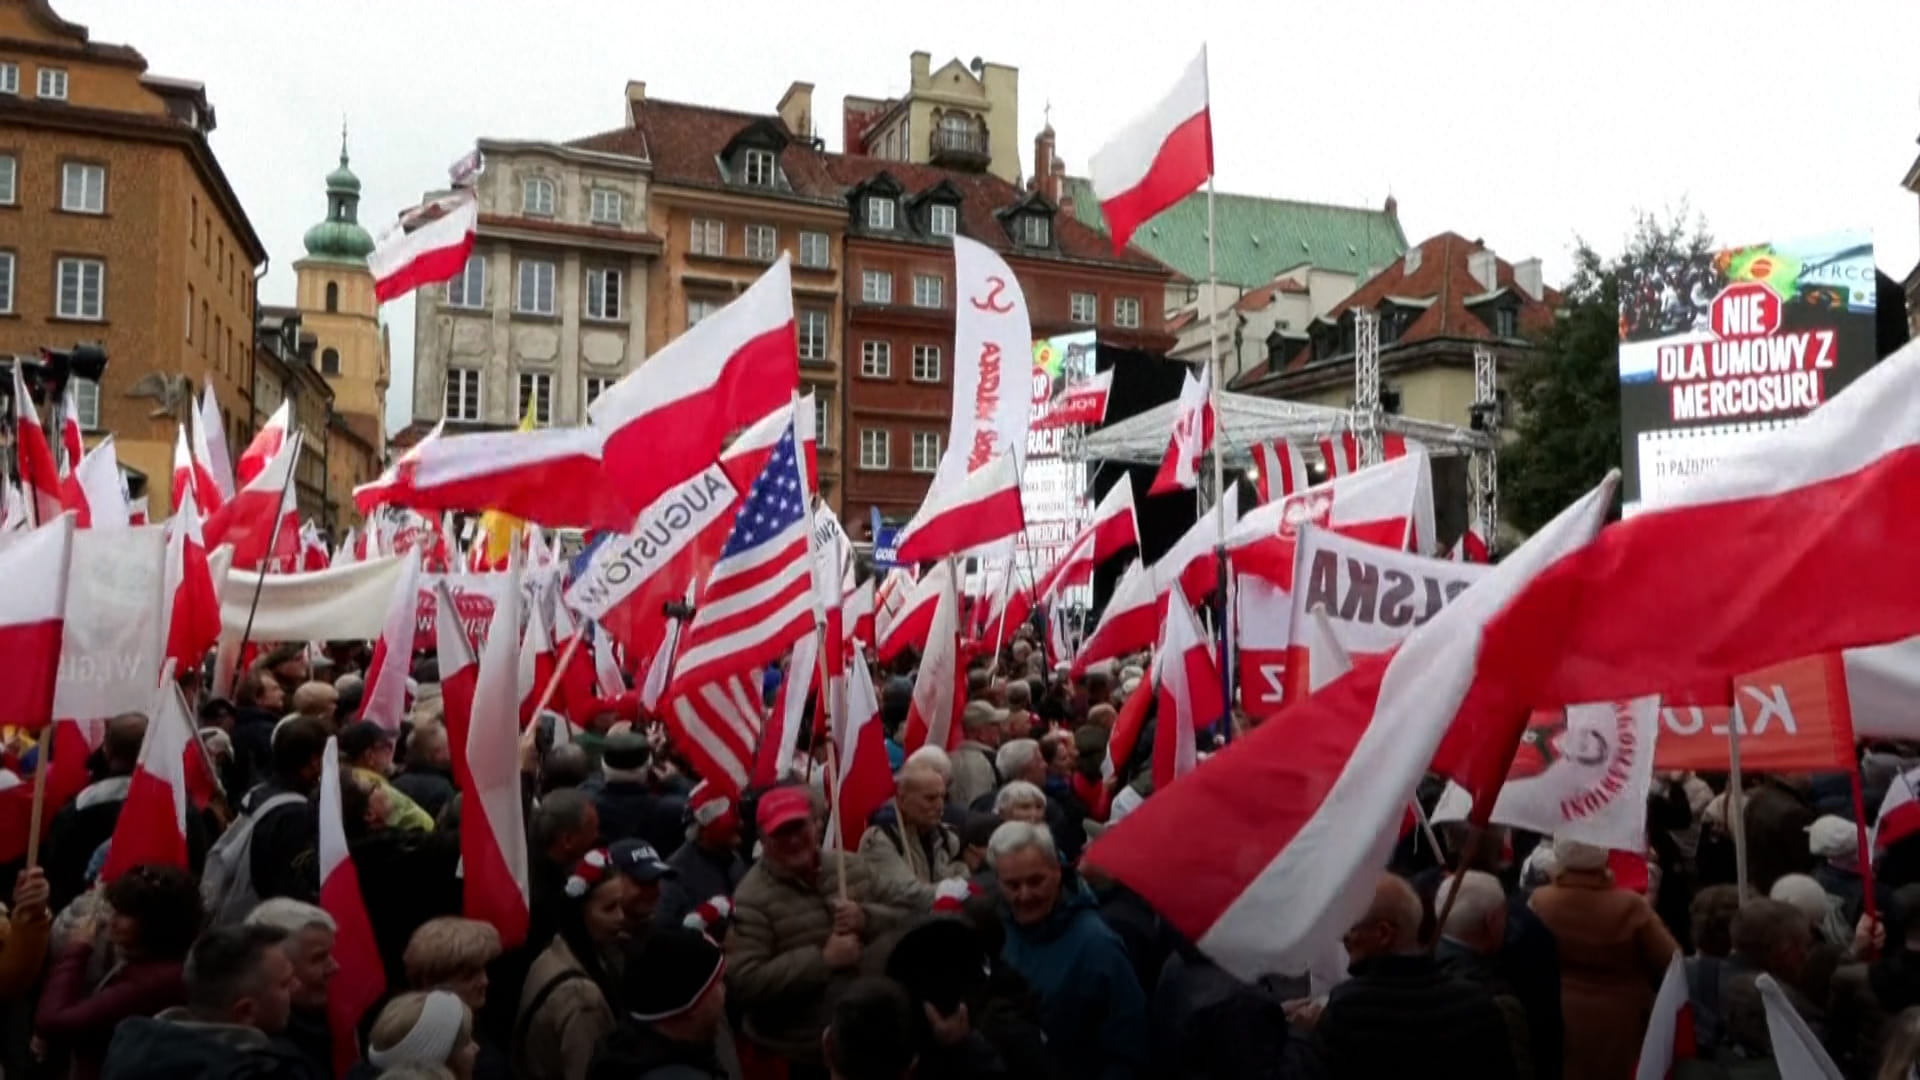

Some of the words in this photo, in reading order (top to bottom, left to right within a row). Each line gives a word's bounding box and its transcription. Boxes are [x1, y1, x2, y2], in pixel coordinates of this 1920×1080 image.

[1722, 292, 1766, 336] NIE
[1660, 346, 1707, 381] DLA
[1711, 333, 1810, 377] UMOWY
[1815, 331, 1834, 368] Z
[1672, 371, 1820, 420] MERCOSUR!
